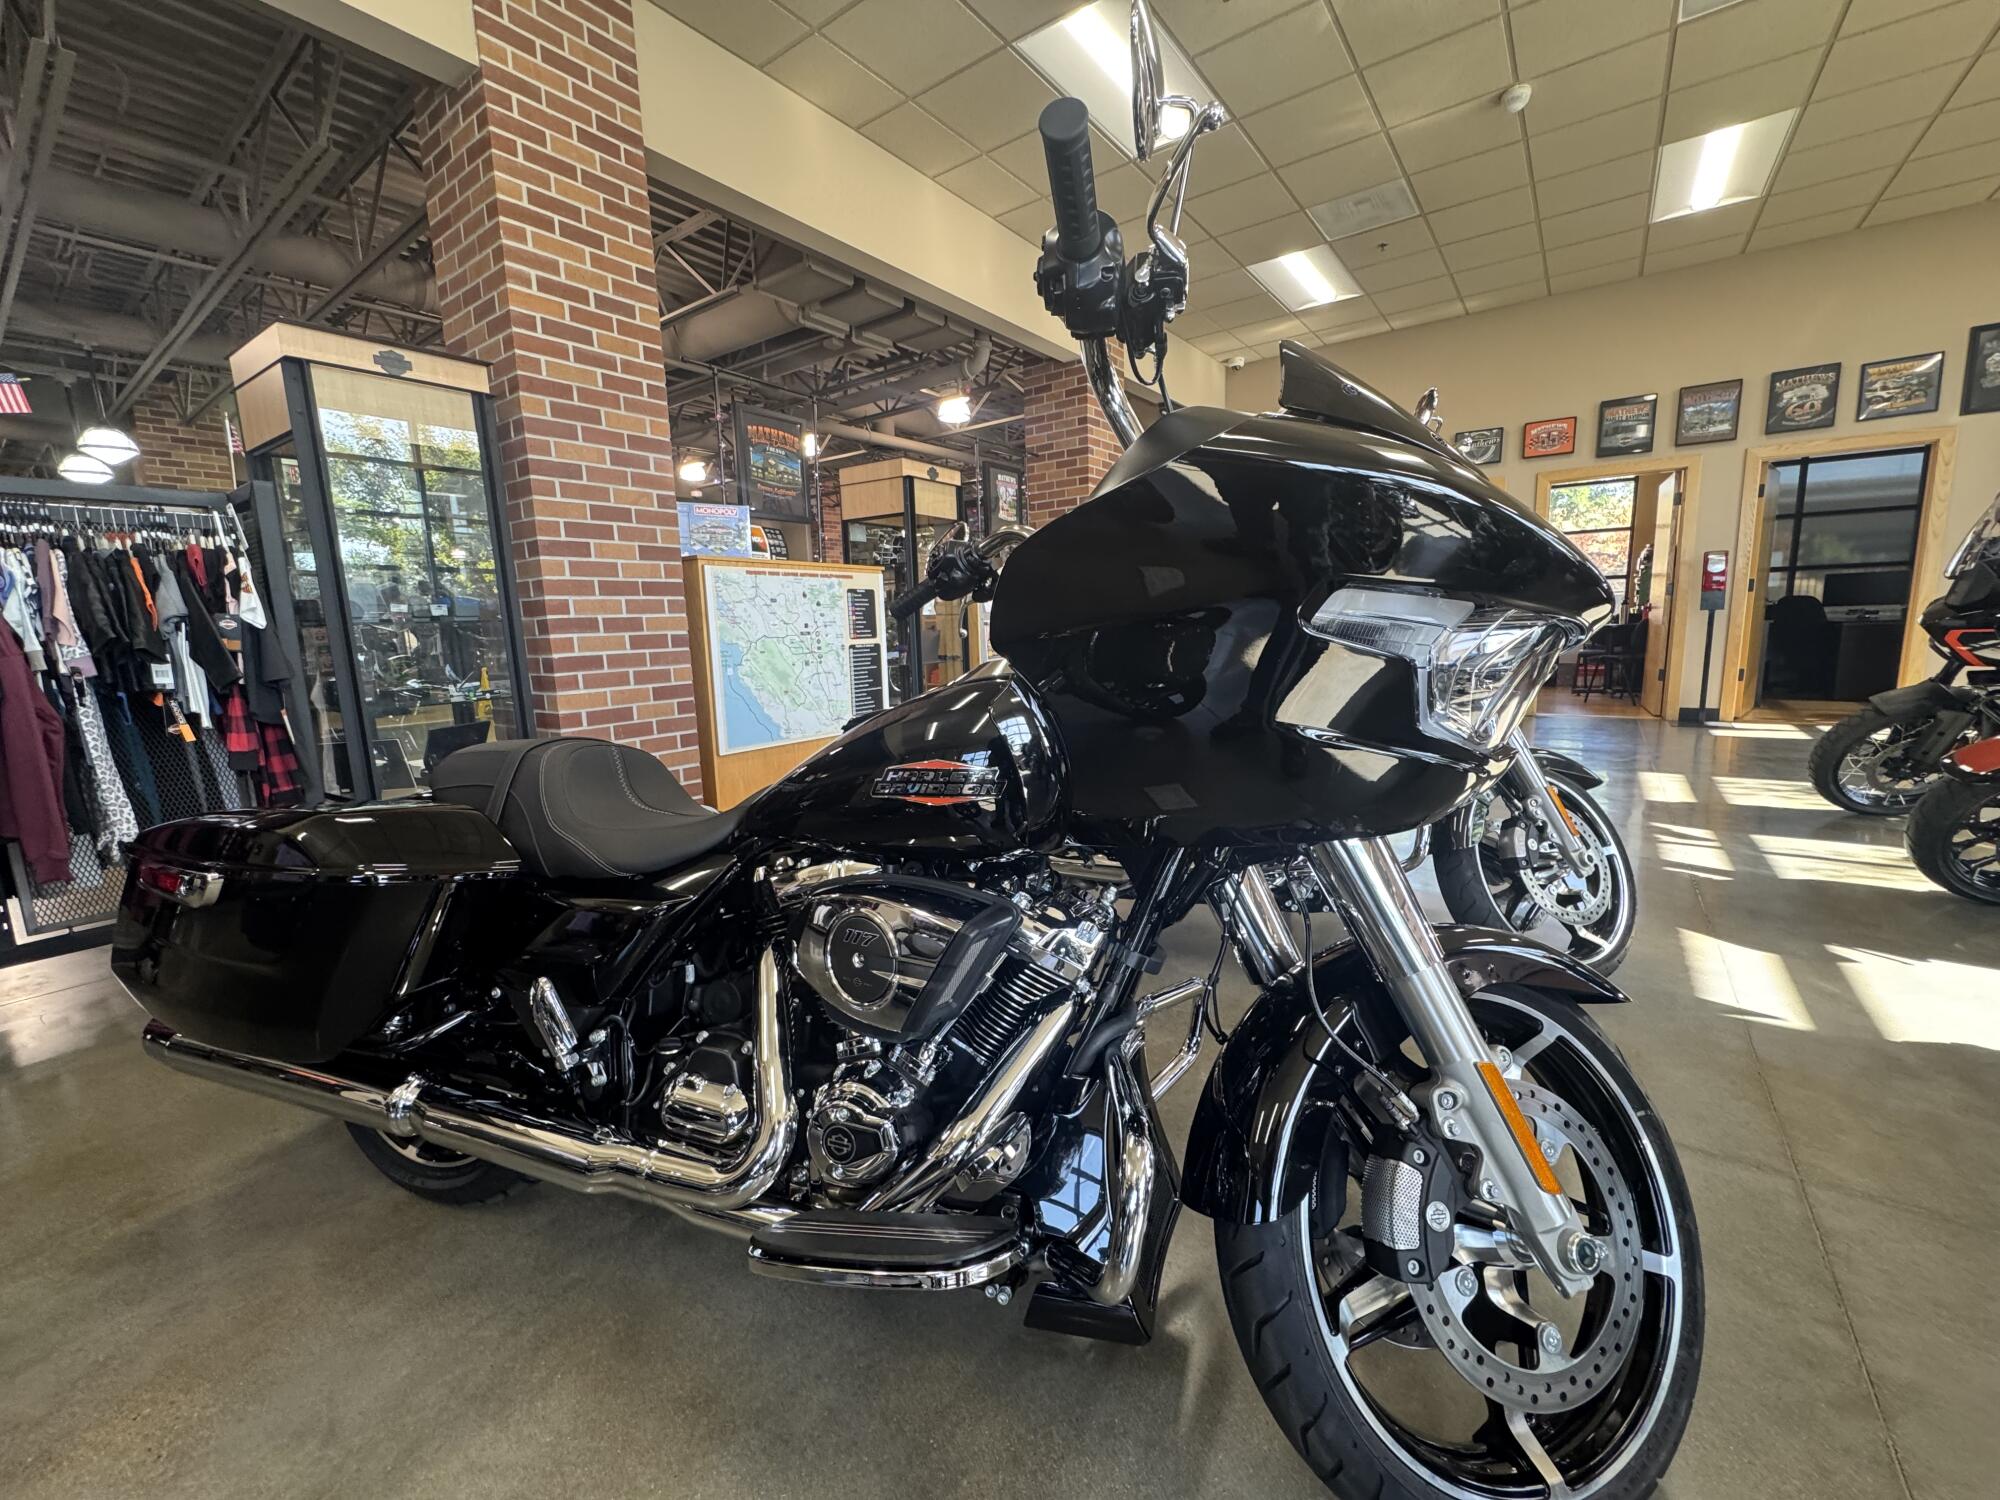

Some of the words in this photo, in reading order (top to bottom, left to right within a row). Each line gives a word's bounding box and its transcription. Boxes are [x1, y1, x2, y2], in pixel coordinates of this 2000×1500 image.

[1776, 372, 1836, 391] MATHEWS
[1604, 403, 1650, 417] MATHEWS
[747, 424, 801, 450] MATHEWS
[695, 507, 737, 516] MONOPOLY
[875, 783, 997, 795] DAVIDSON
[842, 928, 880, 948] 117
